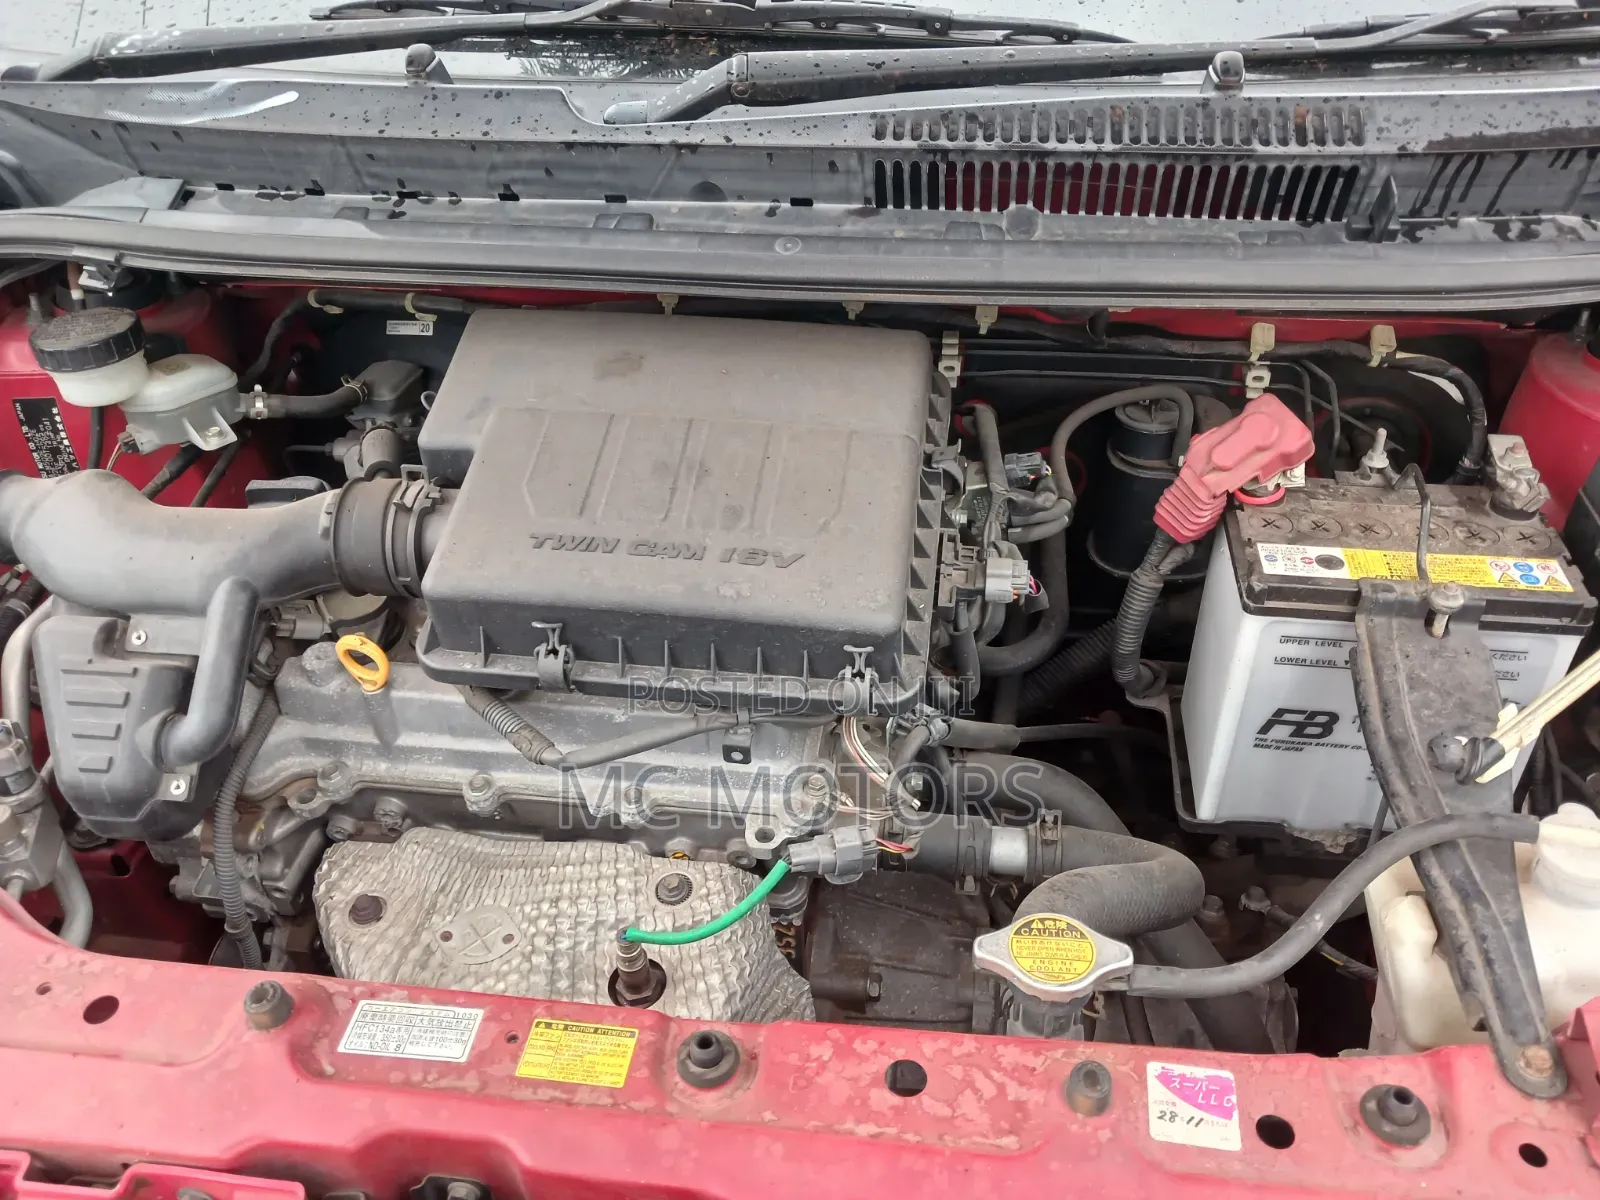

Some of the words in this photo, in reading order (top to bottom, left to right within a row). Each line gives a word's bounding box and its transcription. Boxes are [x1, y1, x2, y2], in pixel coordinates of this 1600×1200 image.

[421, 323, 430, 332] 20
[14, 402, 26, 422] JAPAN
[530, 533, 620, 553] TWIN
[627, 540, 705, 560] CAM
[719, 548, 805, 568] 16V
[1492, 653, 1527, 661] ください
[1256, 708, 1339, 739] FB
[1044, 920, 1068, 929] 危険
[1021, 929, 1081, 938] CAUTION
[416, 1017, 472, 1029] 大気放出禁止
[566, 1025, 594, 1033] CAUTION
[596, 1028, 630, 1037] ATTENTION
[1170, 1078, 1220, 1091] スーパー
[1157, 1110, 1178, 1123] 28
